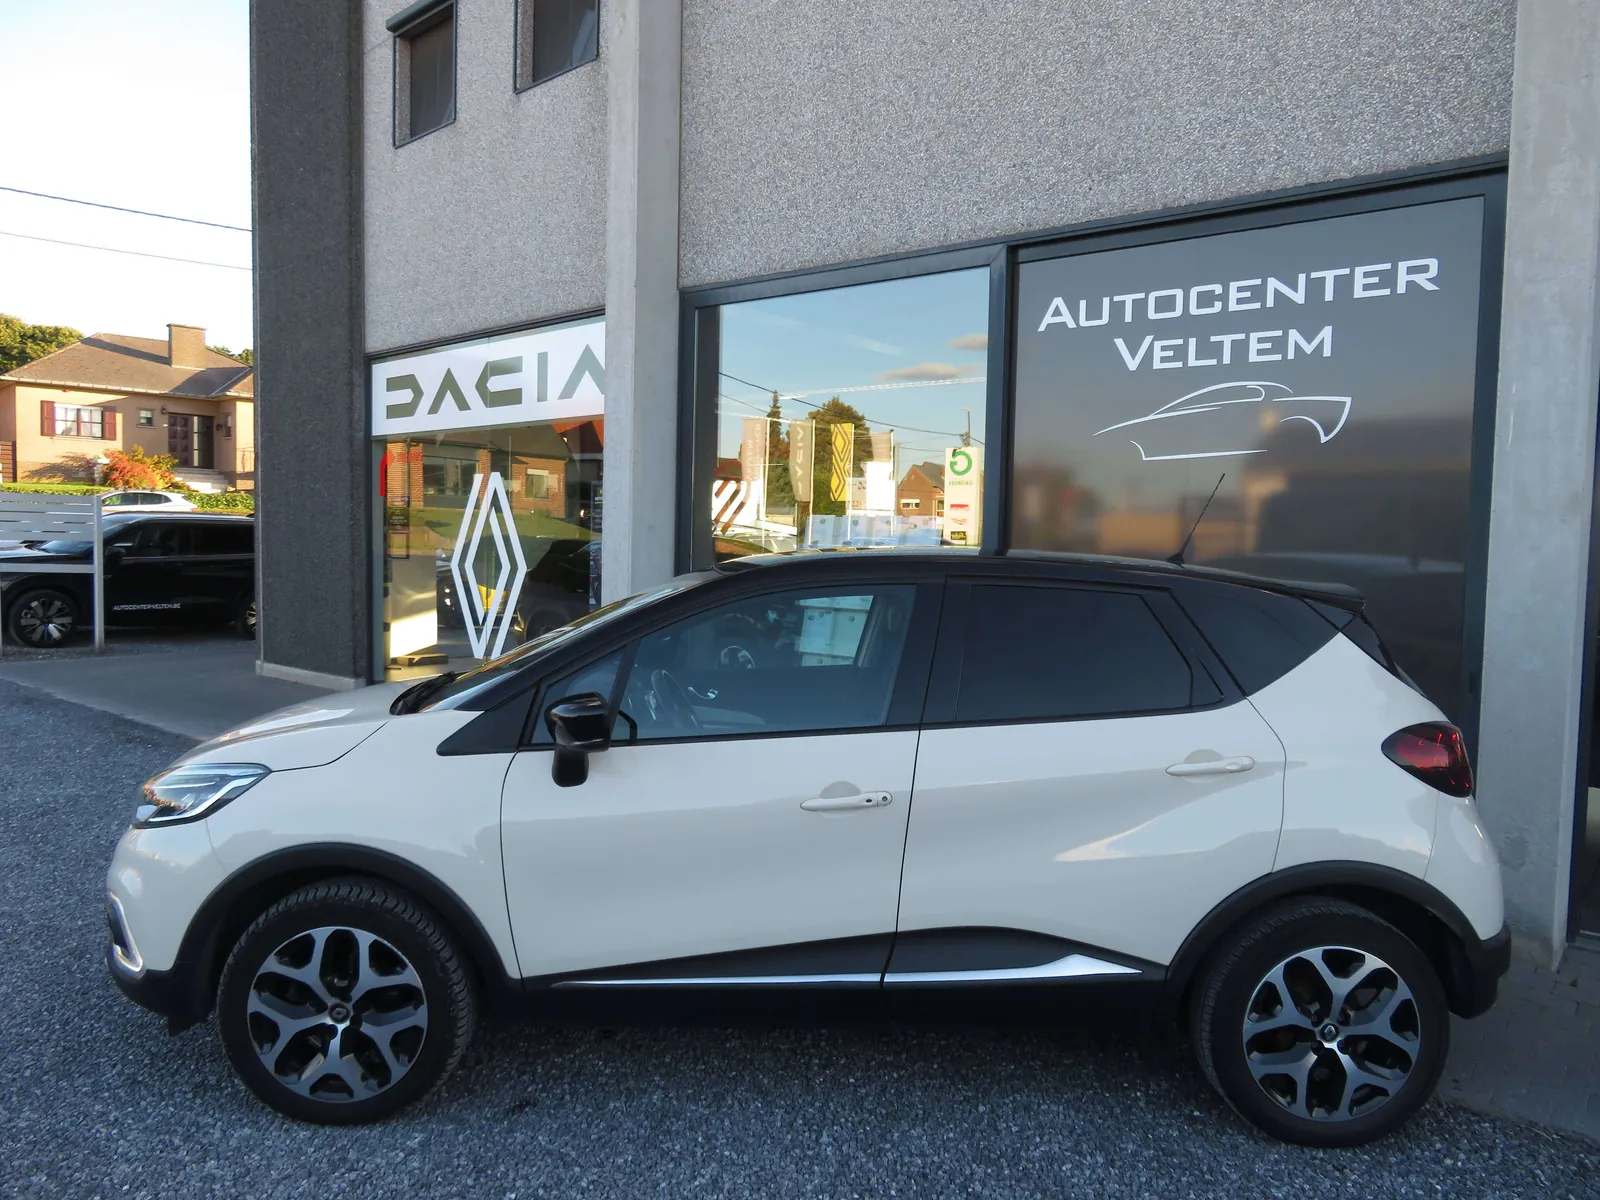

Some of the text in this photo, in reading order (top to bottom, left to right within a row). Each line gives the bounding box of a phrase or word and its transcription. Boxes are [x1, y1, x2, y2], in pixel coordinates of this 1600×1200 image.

[1037, 257, 1440, 332] AUTOCENTER
[386, 344, 606, 420] DACIA
[1113, 325, 1333, 372] VELTEM
